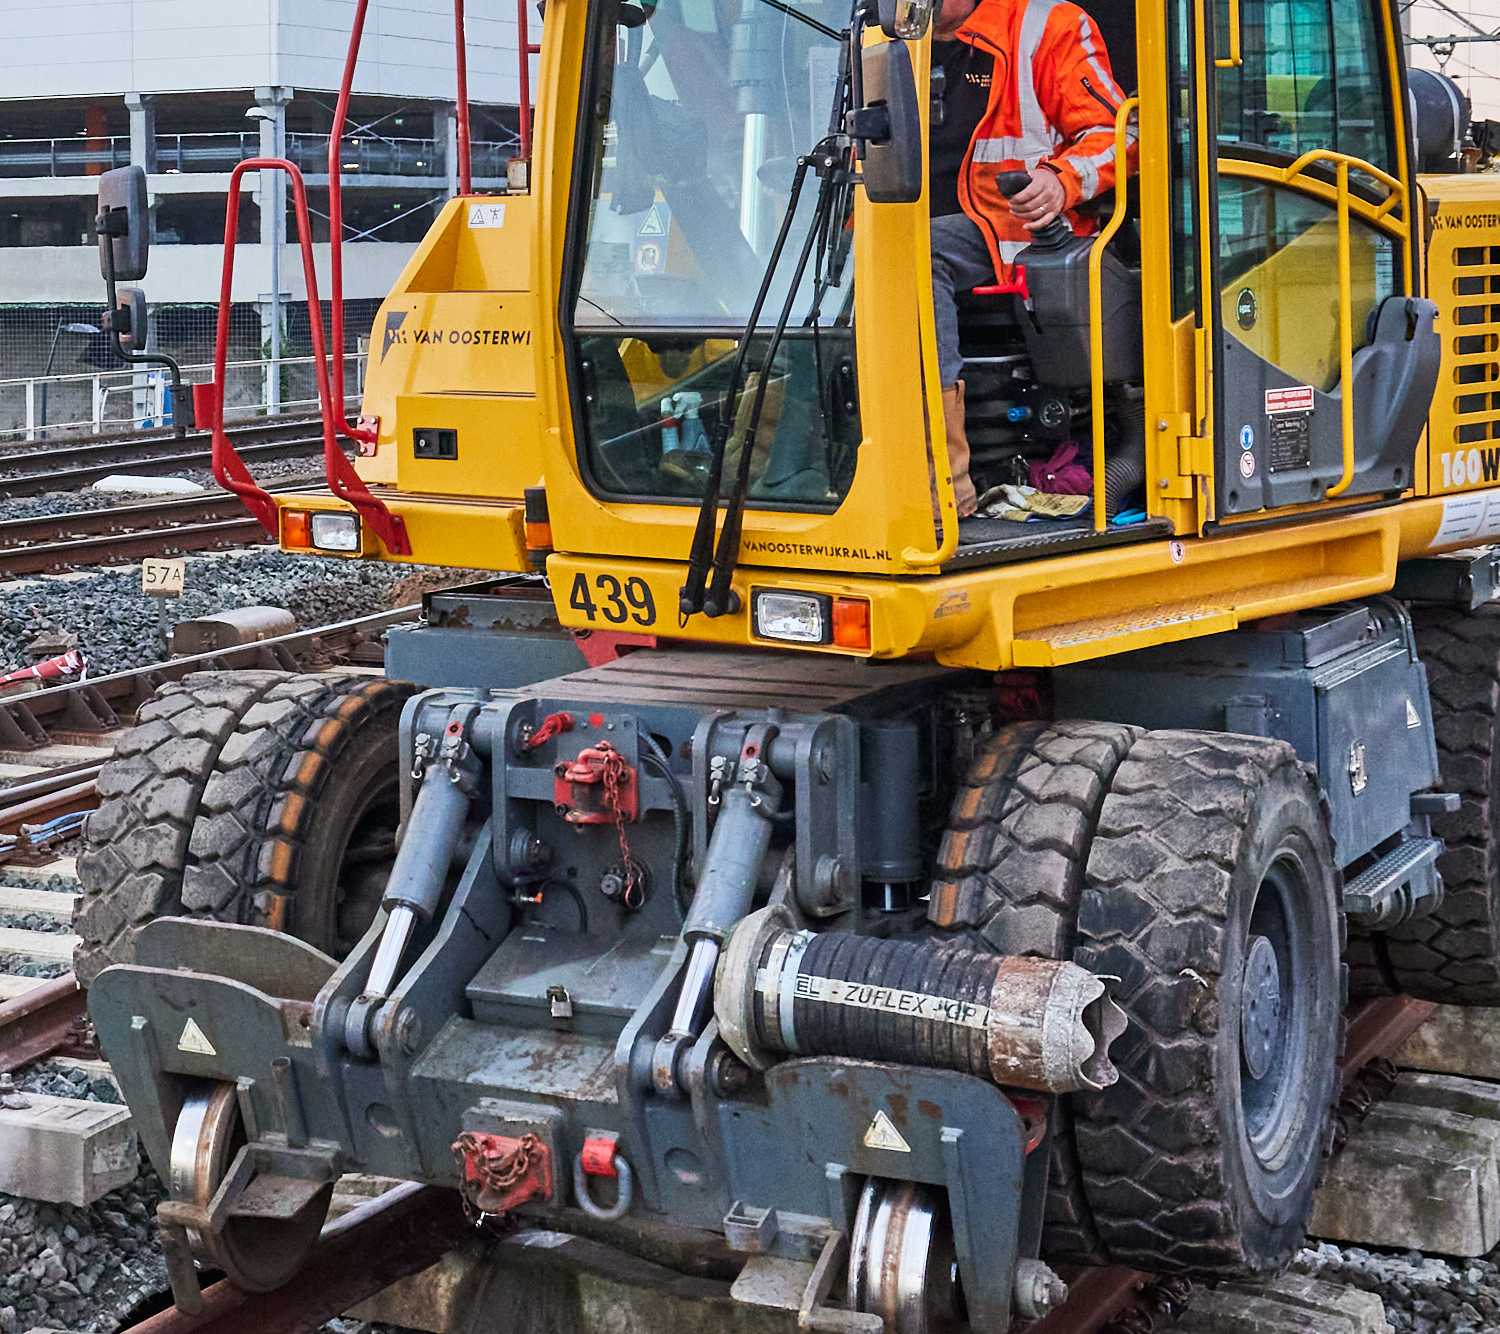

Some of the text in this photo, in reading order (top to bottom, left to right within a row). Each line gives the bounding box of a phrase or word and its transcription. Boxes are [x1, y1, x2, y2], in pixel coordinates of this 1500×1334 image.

[1445, 215, 1462, 229] VAN
[413, 330, 531, 345] VAN OOSTERWI
[743, 540, 893, 561] VANOOSTERWIJKRAIL.NL
[569, 572, 658, 627] 439
